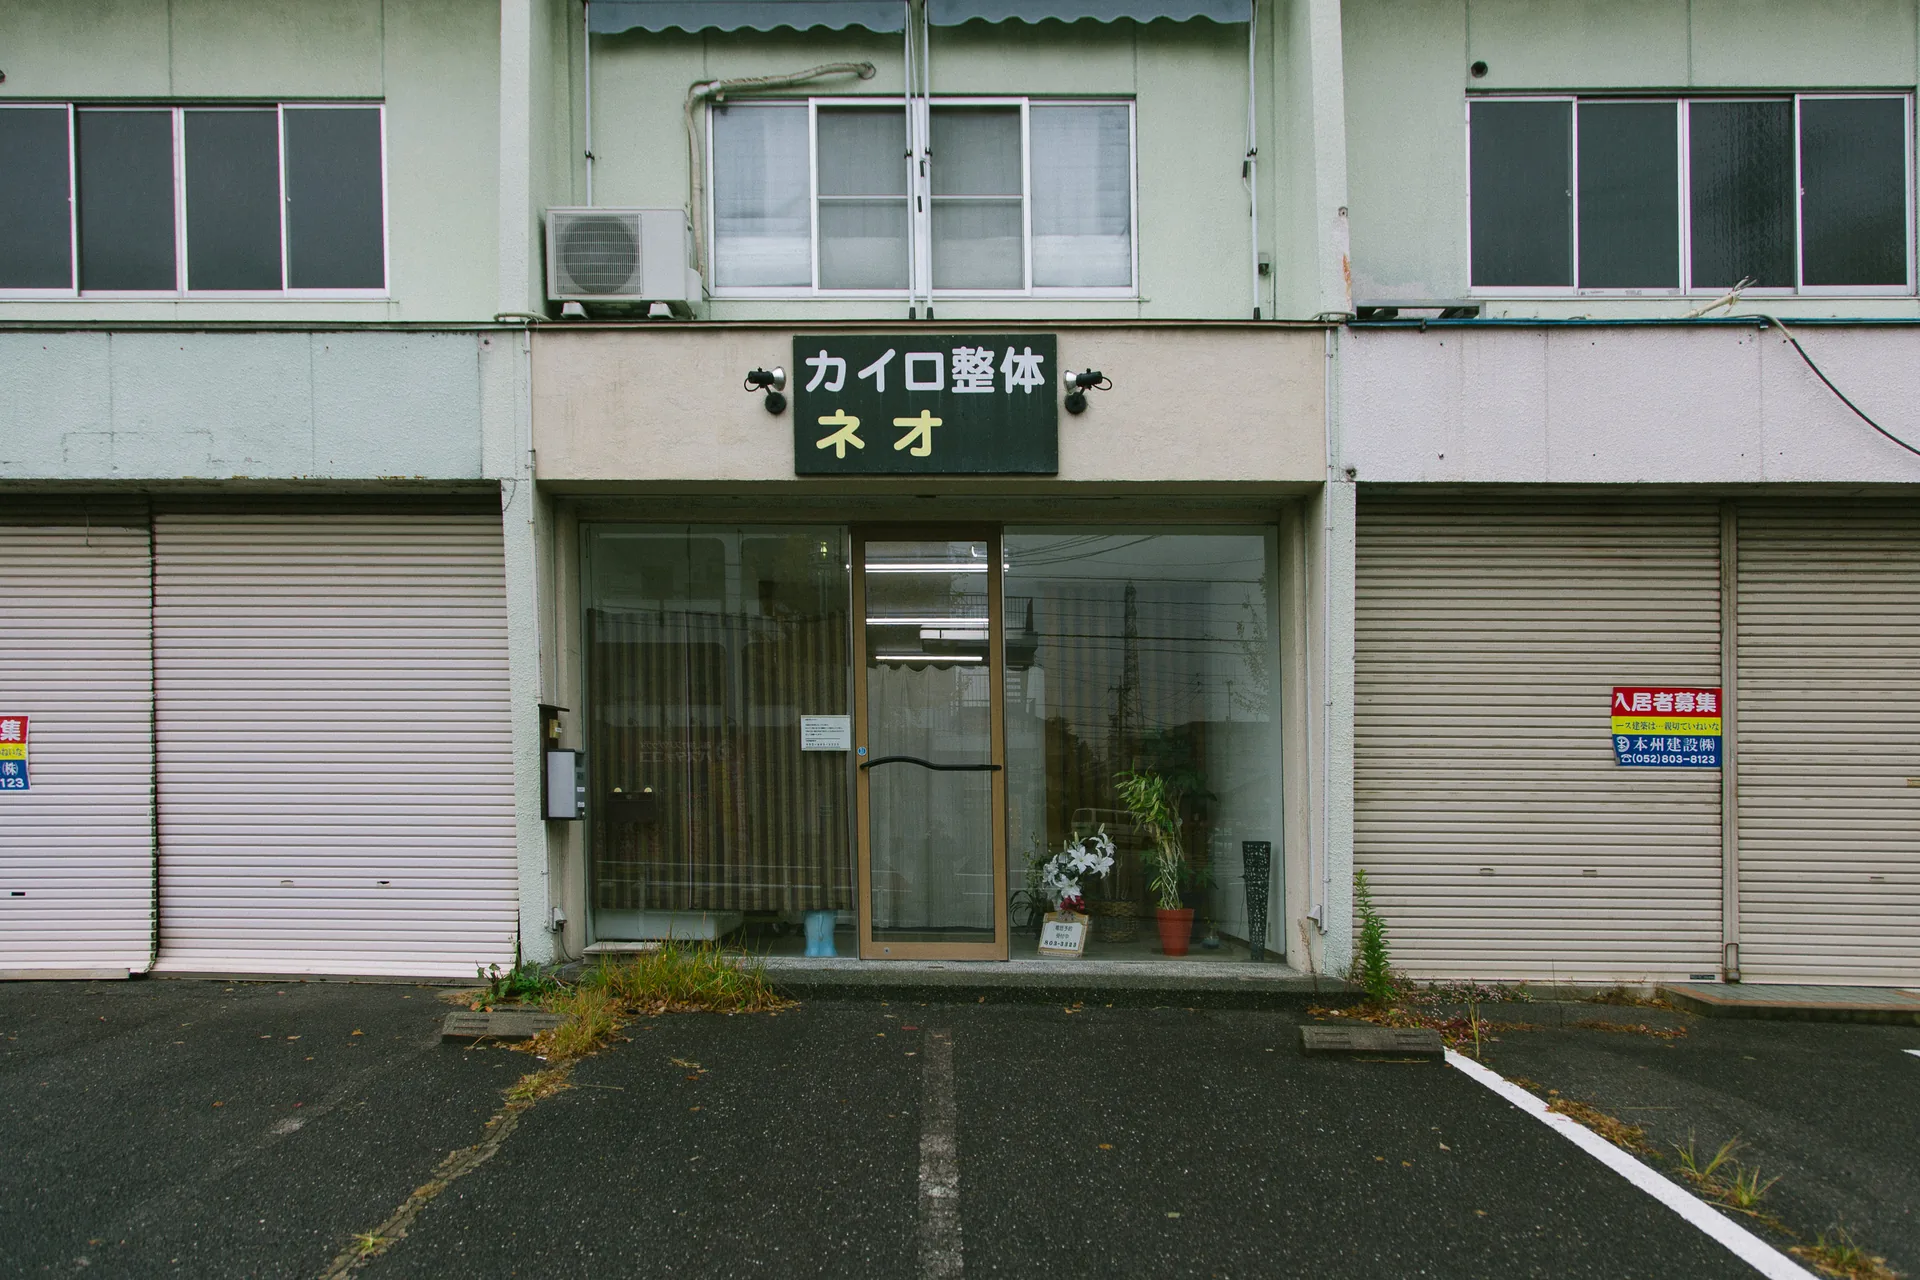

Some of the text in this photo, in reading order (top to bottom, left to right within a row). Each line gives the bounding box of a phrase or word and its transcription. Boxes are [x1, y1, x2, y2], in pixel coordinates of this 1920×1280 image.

[805, 346, 1045, 394] カイロ整体
[816, 409, 943, 459] ネオ
[1614, 692, 1717, 712] 入居者募集
[0, 748, 22, 757] ねいな
